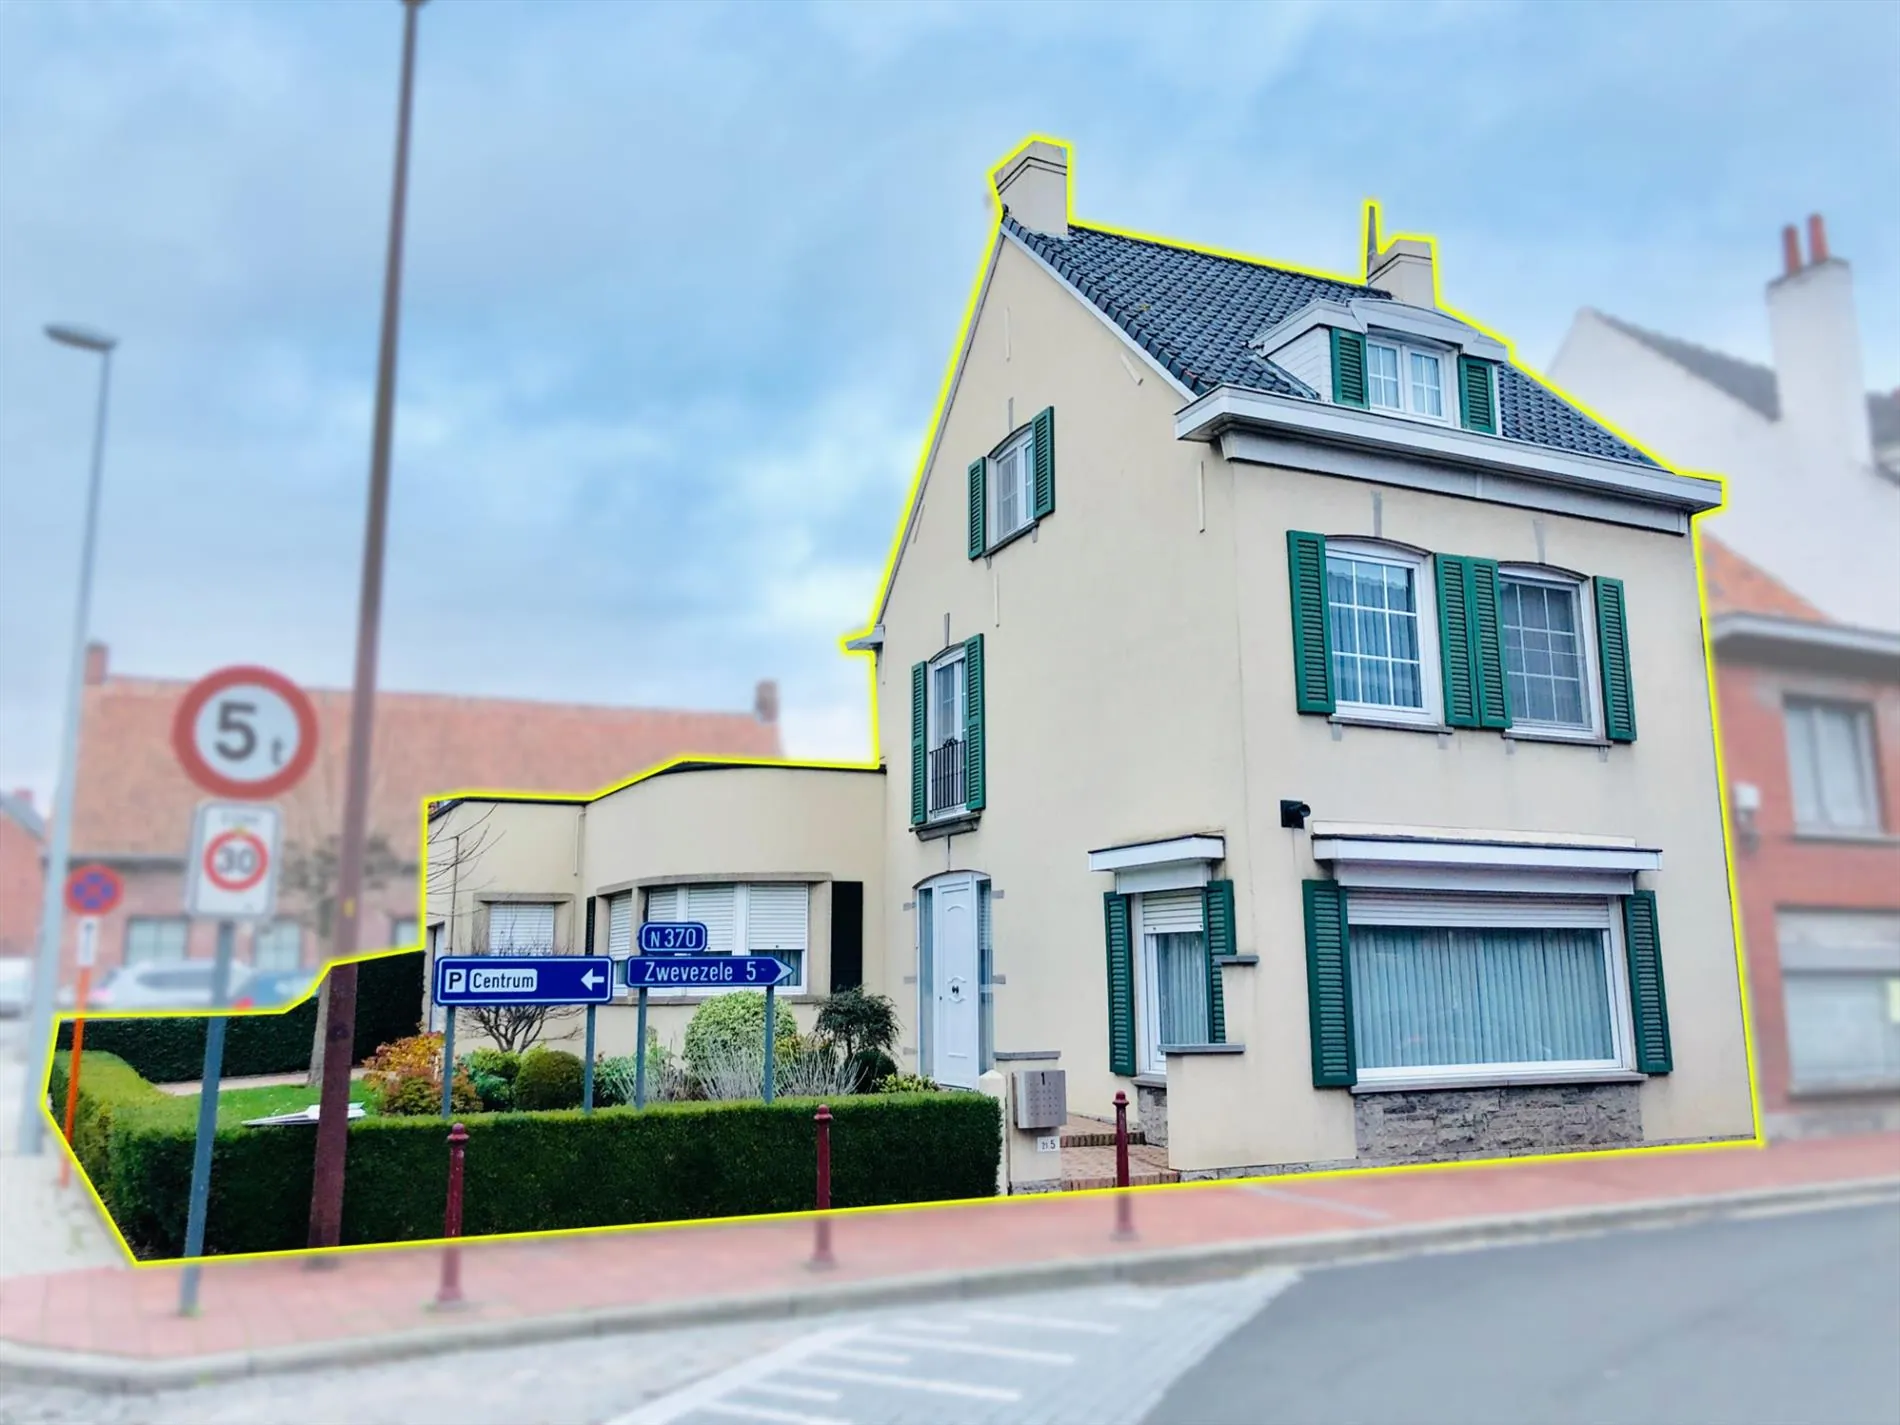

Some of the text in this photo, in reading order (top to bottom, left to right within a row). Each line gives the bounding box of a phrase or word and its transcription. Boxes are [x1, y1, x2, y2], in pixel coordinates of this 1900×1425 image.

[214, 701, 257, 762] 5
[215, 847, 258, 874] 30
[650, 928, 696, 948] N 370
[448, 972, 534, 990] P Centrum
[644, 961, 757, 982] Zwevezele 5
